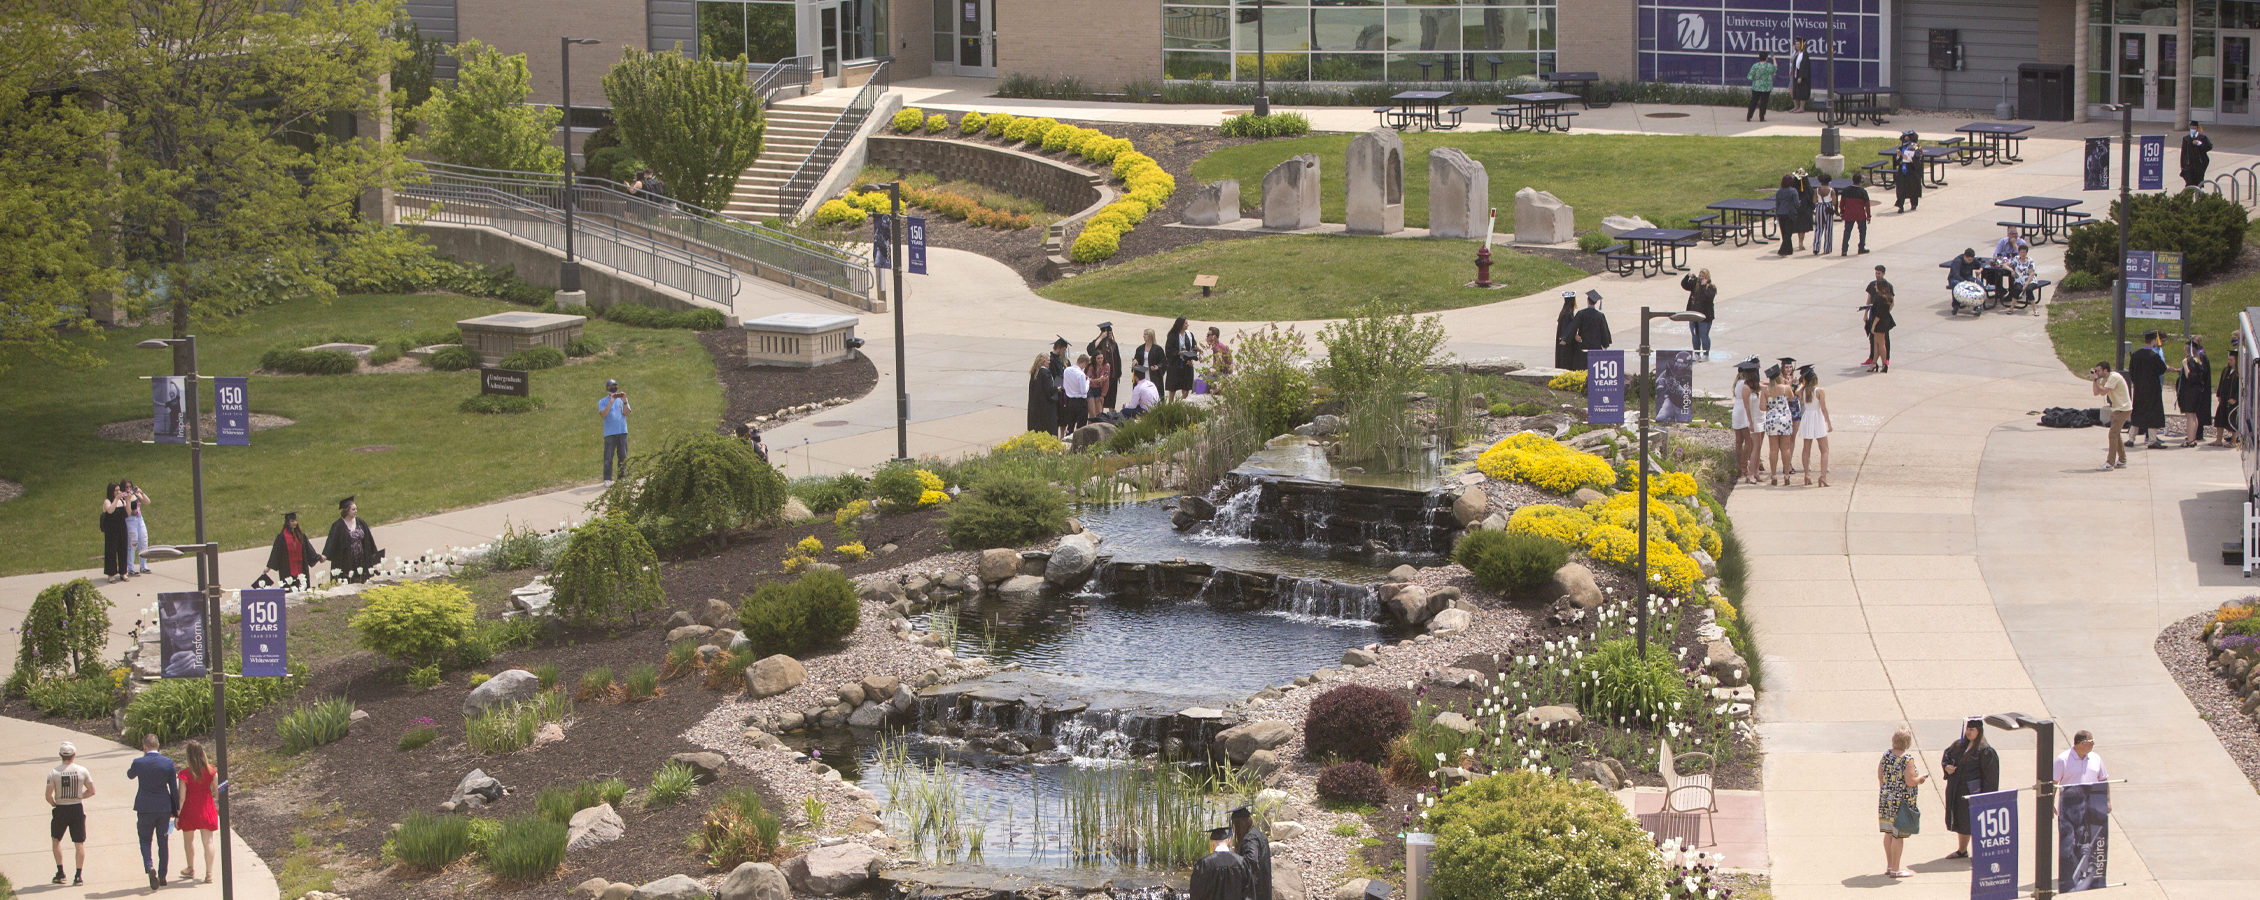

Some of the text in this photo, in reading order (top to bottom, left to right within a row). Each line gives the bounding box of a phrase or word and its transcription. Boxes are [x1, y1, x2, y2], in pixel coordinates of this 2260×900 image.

[1726, 16, 1846, 31] University of Wiscosin
[2143, 143, 2160, 157] 150
[910, 225, 923, 240] 150
[1592, 360, 1618, 379] 150
[490, 373, 522, 383] Undergraduate
[490, 382, 514, 390] Admissions
[219, 386, 242, 404] 150
[1681, 382, 1692, 415] Engage.
[247, 601, 278, 623] 150
[249, 624, 278, 632] YEARS
[192, 619, 203, 670] Transform.
[1977, 807, 2010, 838] 150
[1980, 836, 2011, 848] YEARS
[2093, 836, 2107, 878] Inspire.
[1979, 878, 2011, 887] Whitewater
